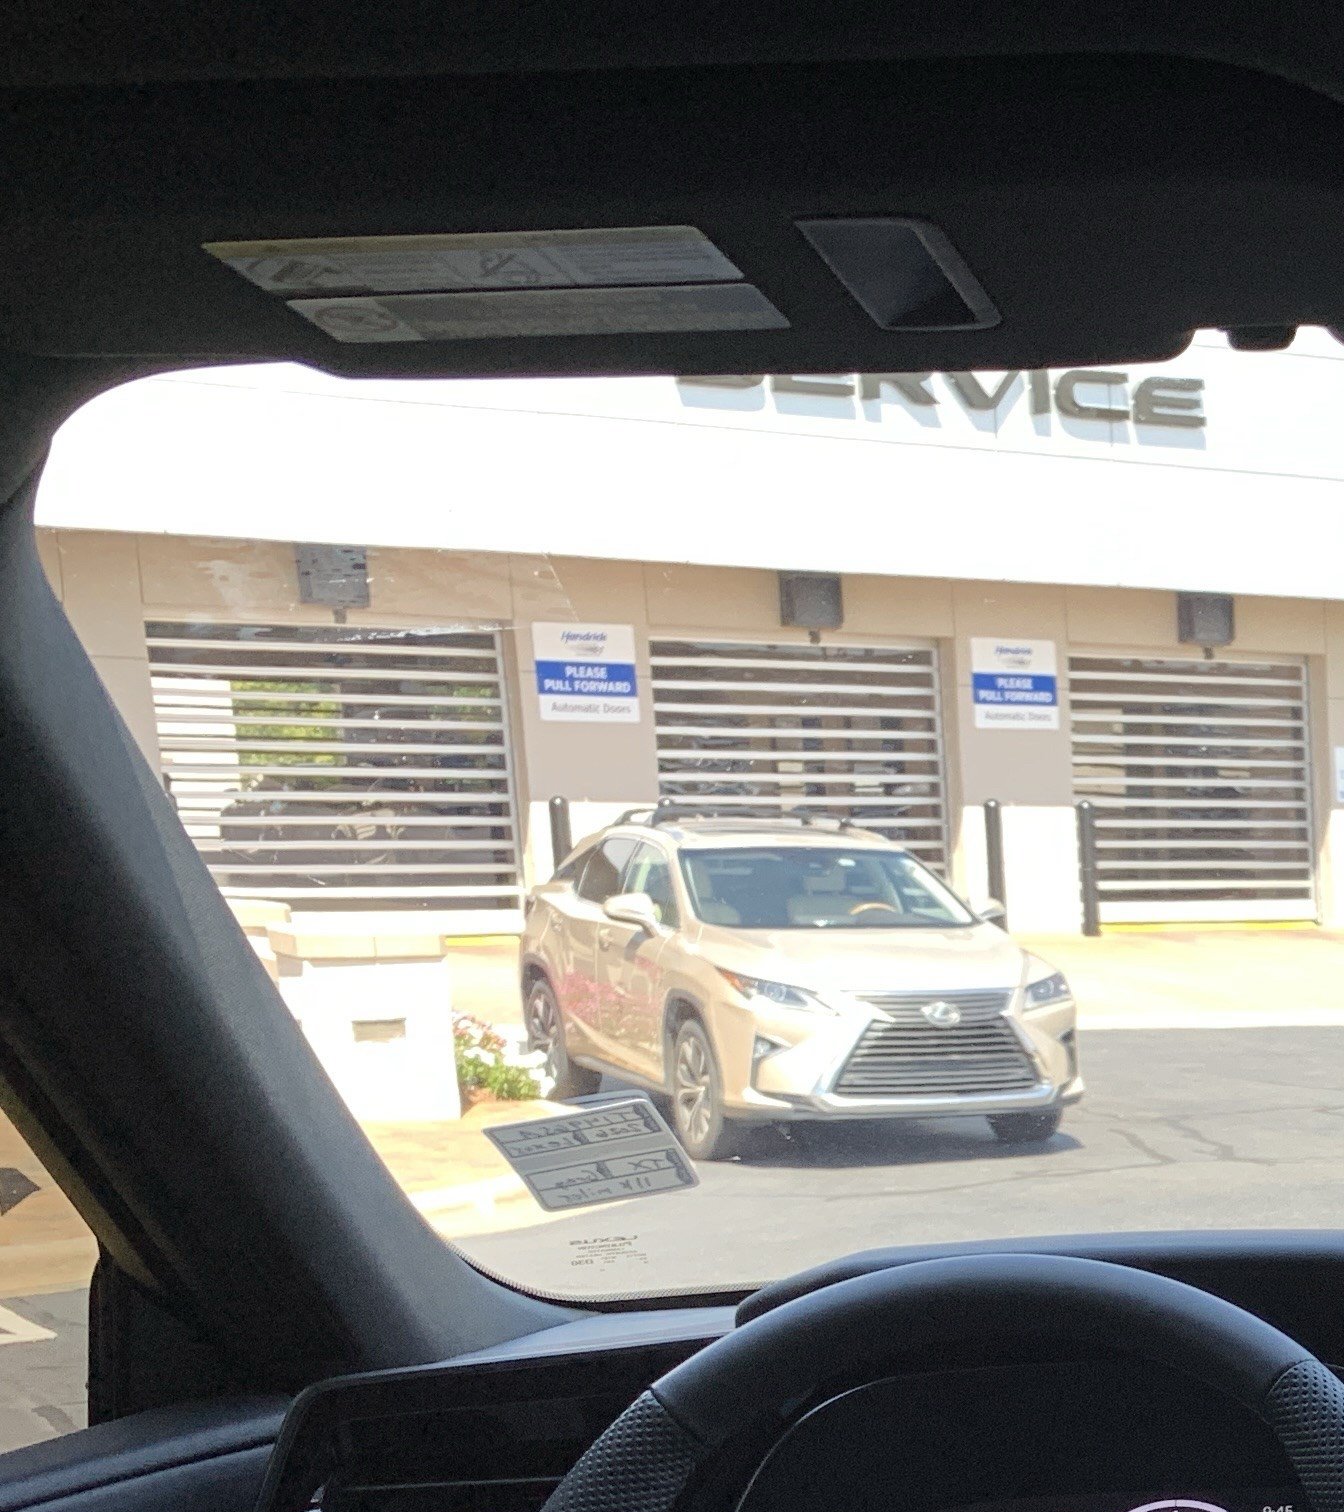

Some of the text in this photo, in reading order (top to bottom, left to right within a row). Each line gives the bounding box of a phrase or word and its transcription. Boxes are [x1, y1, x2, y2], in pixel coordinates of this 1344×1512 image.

[565, 666, 607, 679] PLEASE
[543, 679, 631, 693] PULL FORWARD
[551, 702, 631, 714] Automatic Doors
